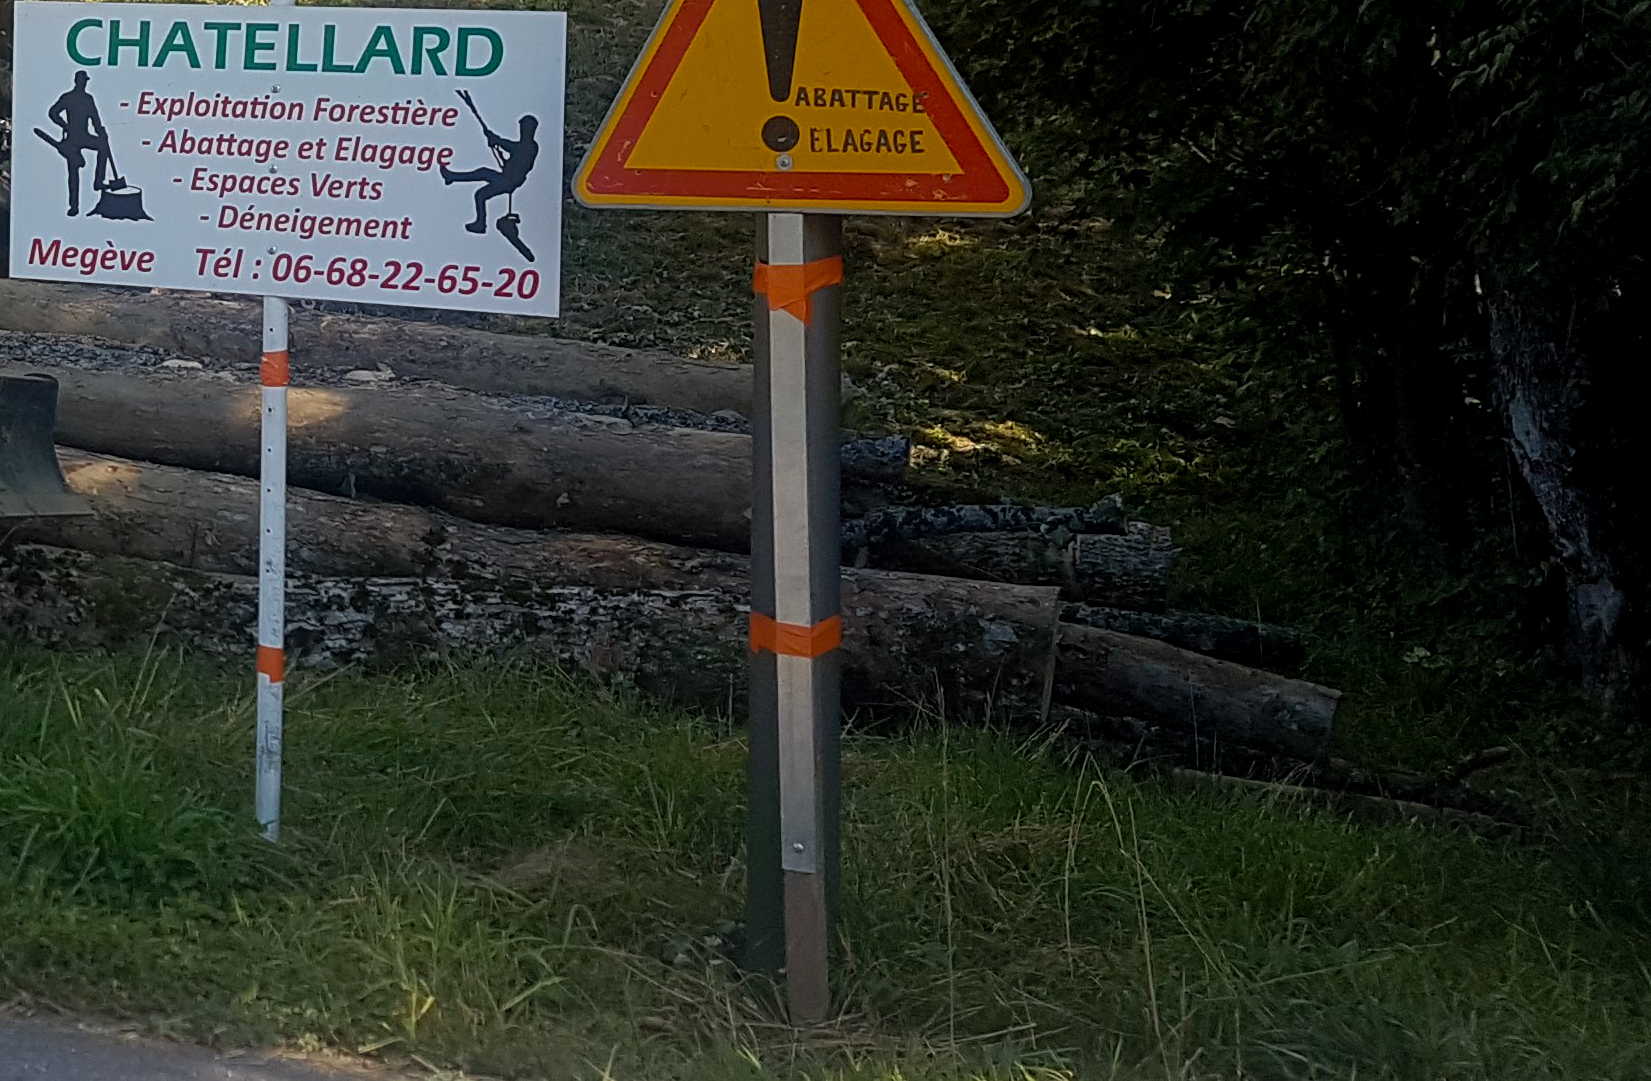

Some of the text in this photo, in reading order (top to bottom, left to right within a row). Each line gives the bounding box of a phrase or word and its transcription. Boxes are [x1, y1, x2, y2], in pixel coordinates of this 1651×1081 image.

[65, 17, 505, 77] CHATELLARD
[137, 91, 304, 122] Exploitation
[313, 97, 459, 127] Forestière
[794, 85, 928, 114] ABATTAGE
[158, 129, 290, 164] Abattage
[297, 139, 327, 161] et
[334, 135, 454, 171] Elagage
[809, 126, 925, 154] ELAGAGE
[190, 167, 301, 198] Espaces
[310, 172, 384, 201] Verts
[217, 204, 413, 240] Déneigement
[28, 237, 156, 276] Megève
[195, 247, 245, 279] Tél
[271, 252, 541, 300] 06-68-22-65-20
